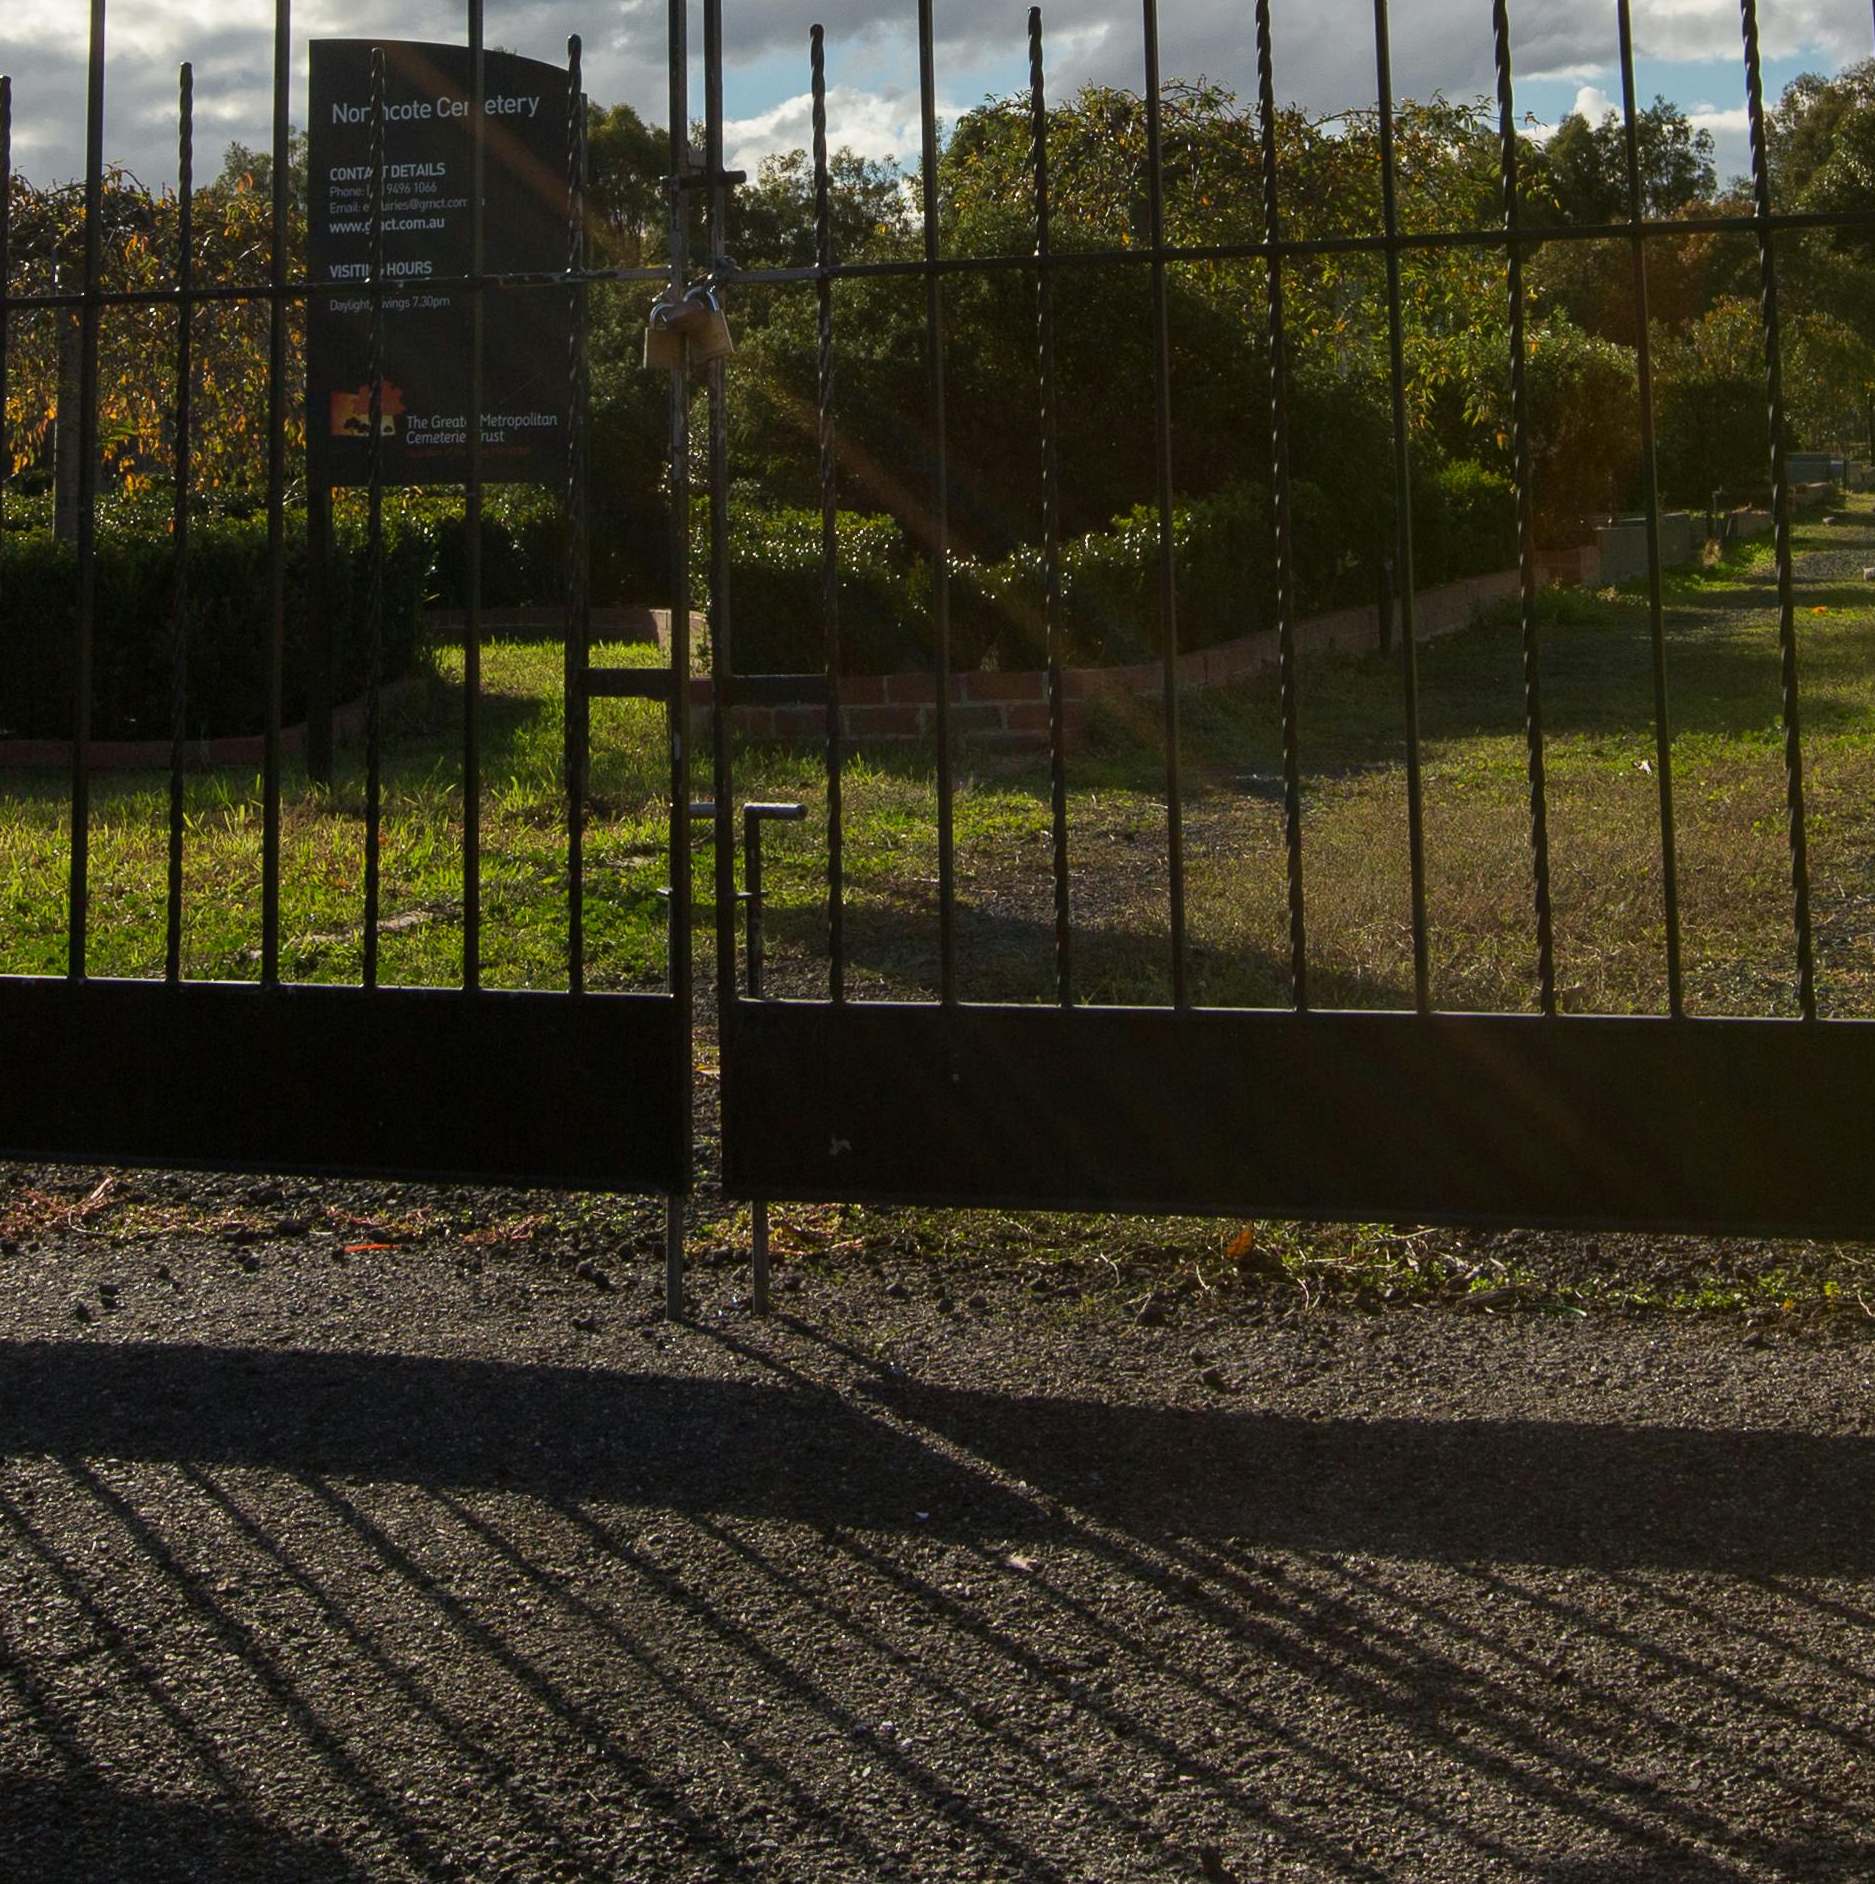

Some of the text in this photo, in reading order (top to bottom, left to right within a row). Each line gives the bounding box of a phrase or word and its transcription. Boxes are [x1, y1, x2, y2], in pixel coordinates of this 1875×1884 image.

[331, 99, 432, 124] Norhcote
[330, 161, 446, 182] CONTAT DETAILS
[329, 186, 364, 198] Phone:
[387, 182, 411, 195] 9496
[414, 181, 438, 194] 1066
[329, 201, 361, 214] Email:
[387, 261, 433, 276] HOURS
[412, 295, 451, 311] 7.30pm
[406, 414, 428, 430] The
[479, 411, 558, 430] Metropolitan
[406, 430, 467, 445] Cemeterie
